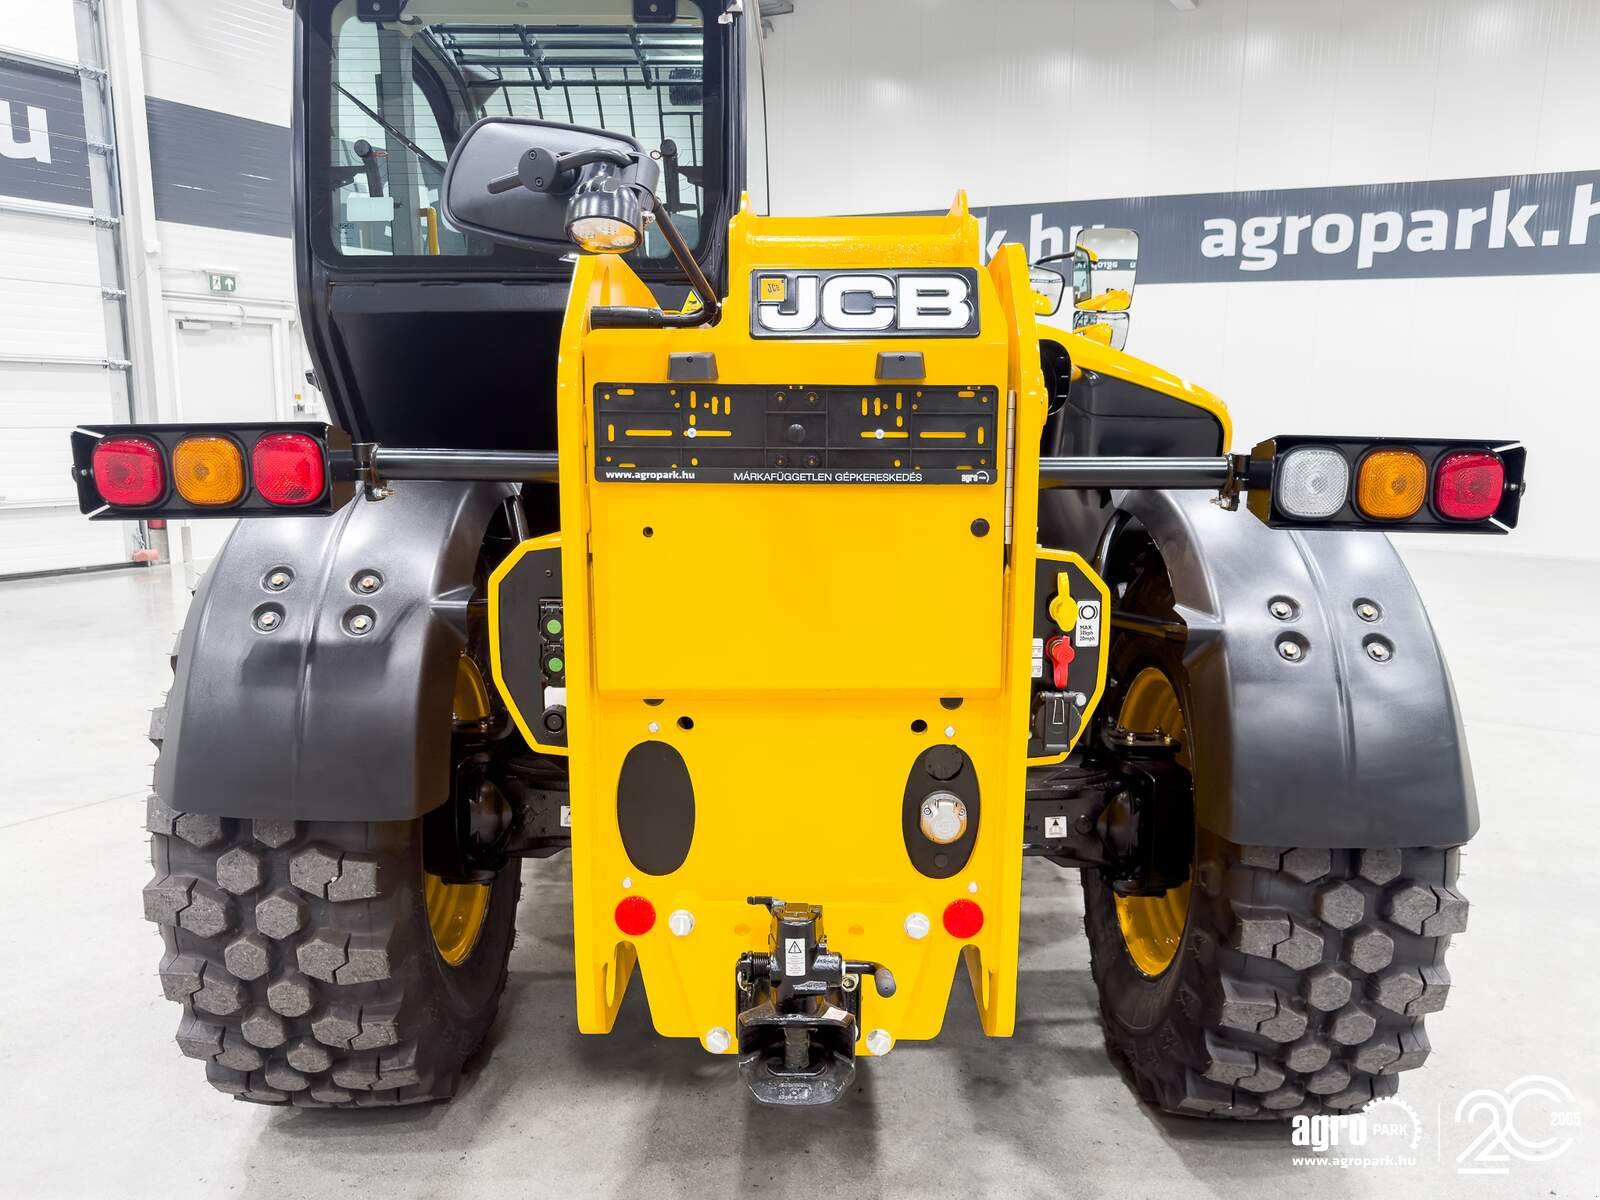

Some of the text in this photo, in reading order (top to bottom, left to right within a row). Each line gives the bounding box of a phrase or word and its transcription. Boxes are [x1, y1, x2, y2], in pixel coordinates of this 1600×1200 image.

[758, 274, 973, 331] JCB
[605, 470, 695, 481] www.agropark.hu
[733, 470, 922, 482] MÁRKAFÜGGETLEN GÉPKERESKEDÉS
